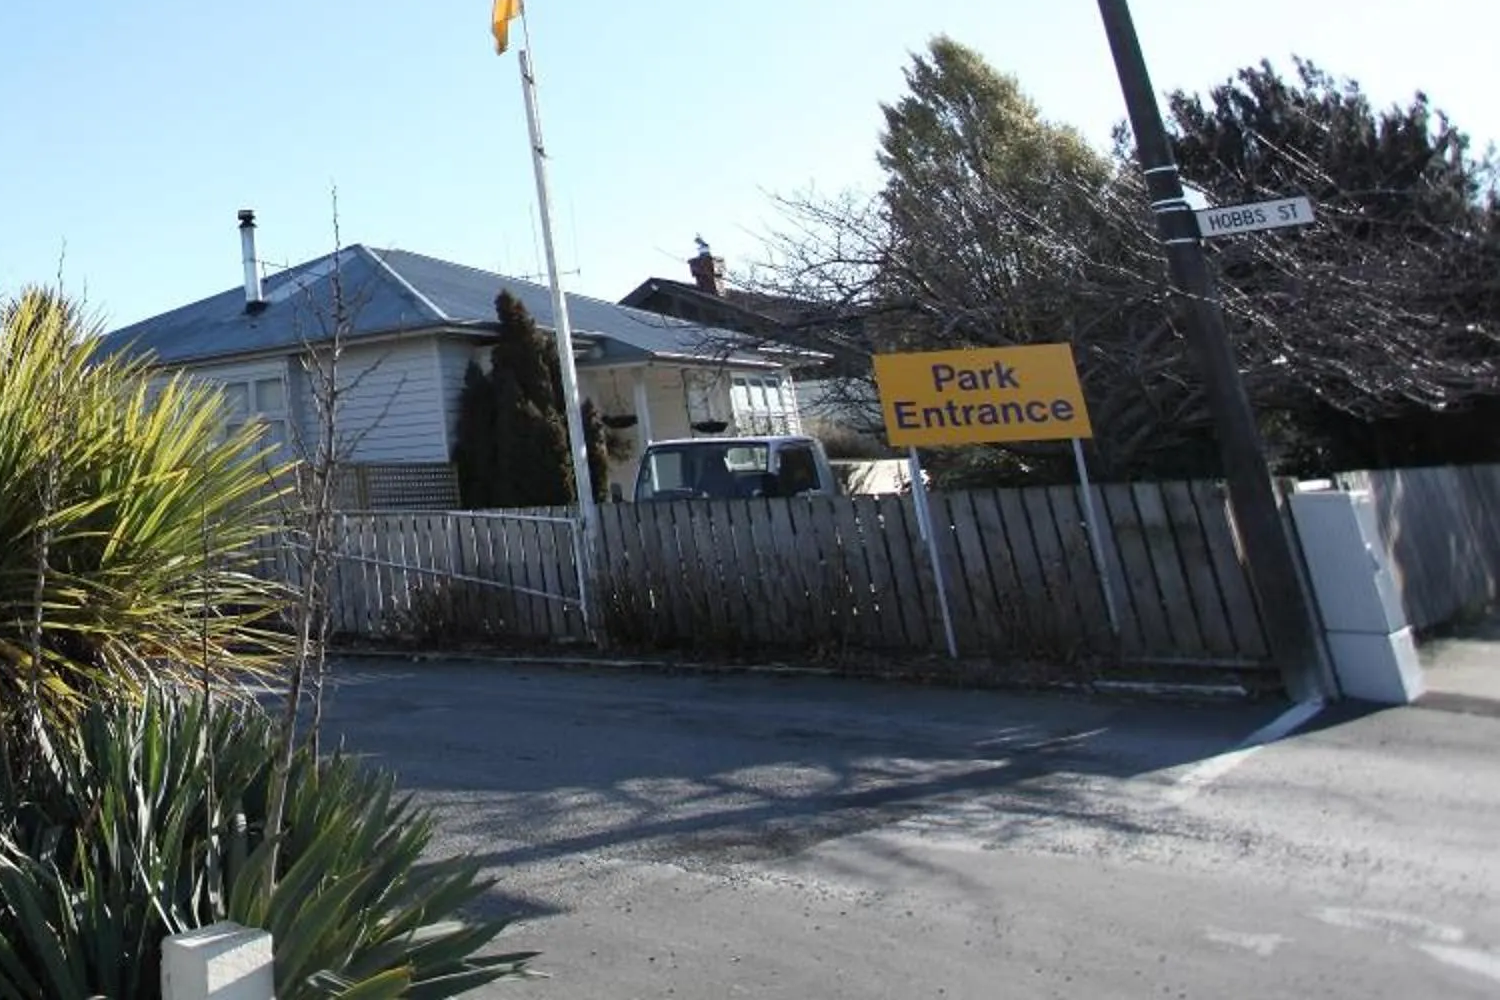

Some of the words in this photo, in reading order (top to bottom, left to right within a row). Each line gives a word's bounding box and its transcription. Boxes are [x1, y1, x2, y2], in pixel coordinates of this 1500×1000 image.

[1208, 209, 1266, 230] HOBBS
[1277, 203, 1298, 220] ST
[931, 360, 1019, 392] Park
[893, 398, 1074, 429] Entrance
